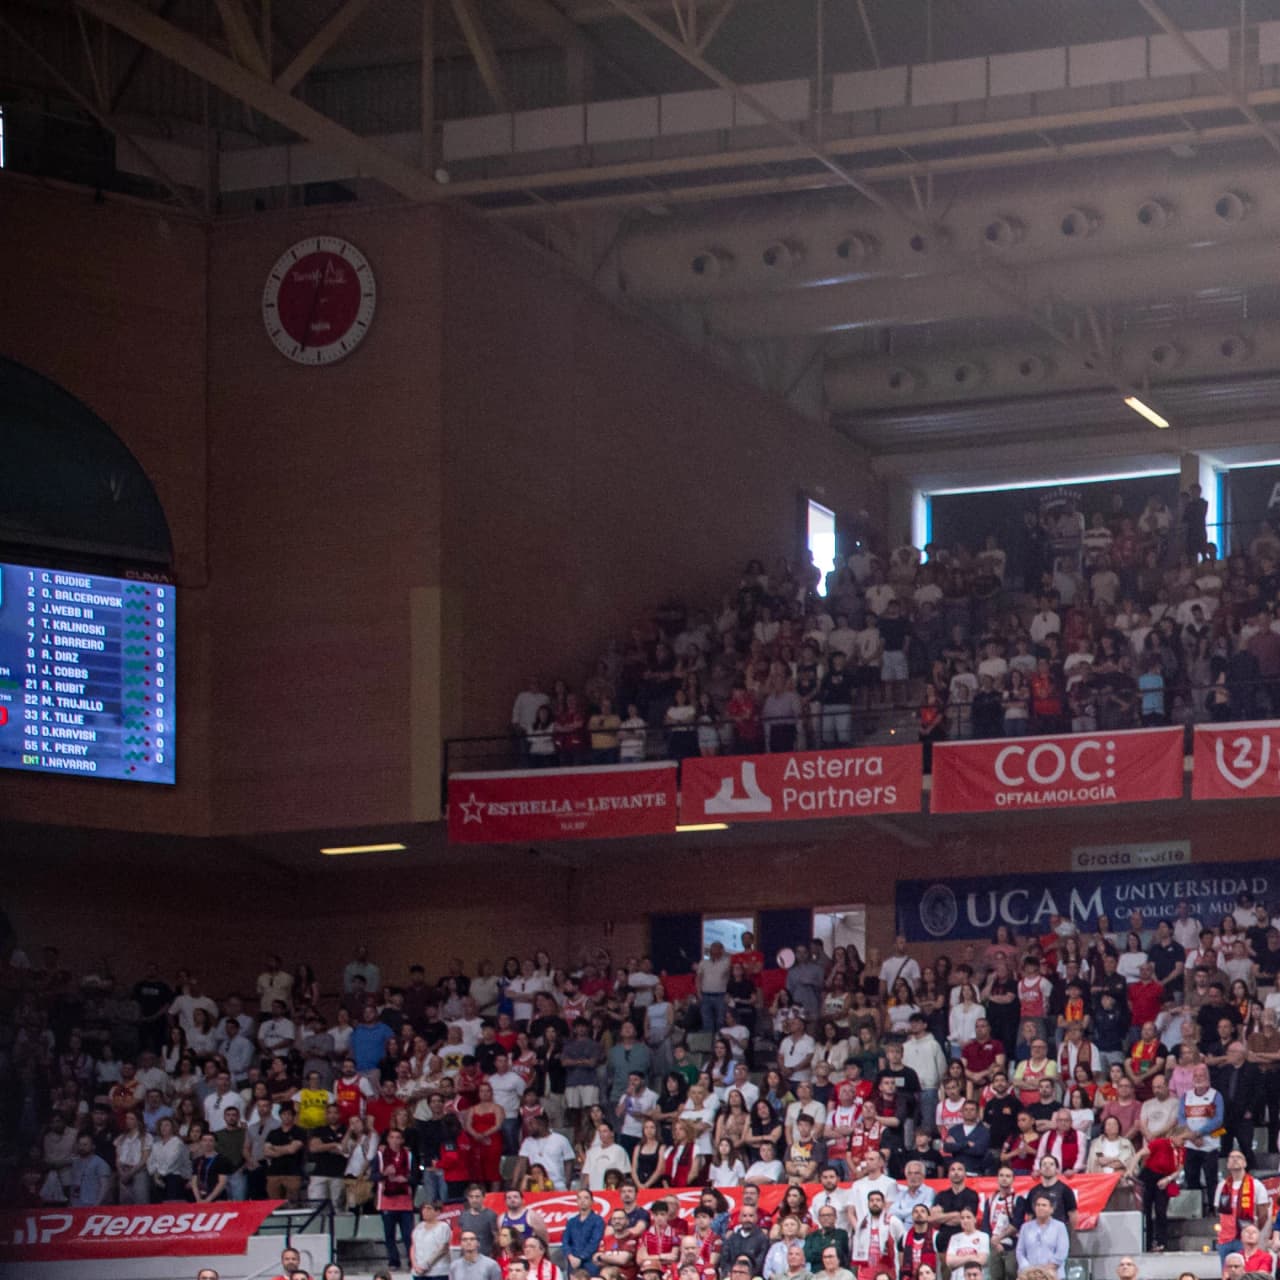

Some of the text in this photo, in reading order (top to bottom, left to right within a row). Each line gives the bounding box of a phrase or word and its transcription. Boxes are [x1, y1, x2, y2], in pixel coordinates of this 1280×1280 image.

[27, 588, 35, 597] 2
[27, 602, 35, 612] 3
[27, 618, 35, 628] 4
[27, 633, 34, 643] 7
[26, 664, 36, 674] 11
[25, 680, 37, 690] 21
[24, 694, 38, 704] 22
[24, 710, 38, 720] 33
[24, 741, 38, 751] 55
[783, 756, 884, 781] Asterra
[783, 783, 897, 812] Partners
[995, 785, 1116, 806] OFTALMOLOGÍA
[488, 793, 667, 816] ESTRELLA LEVANTE
[1077, 852, 1131, 867] Grada
[1114, 877, 1268, 901] UNIVERSIDAD
[966, 886, 1105, 927] UCAM
